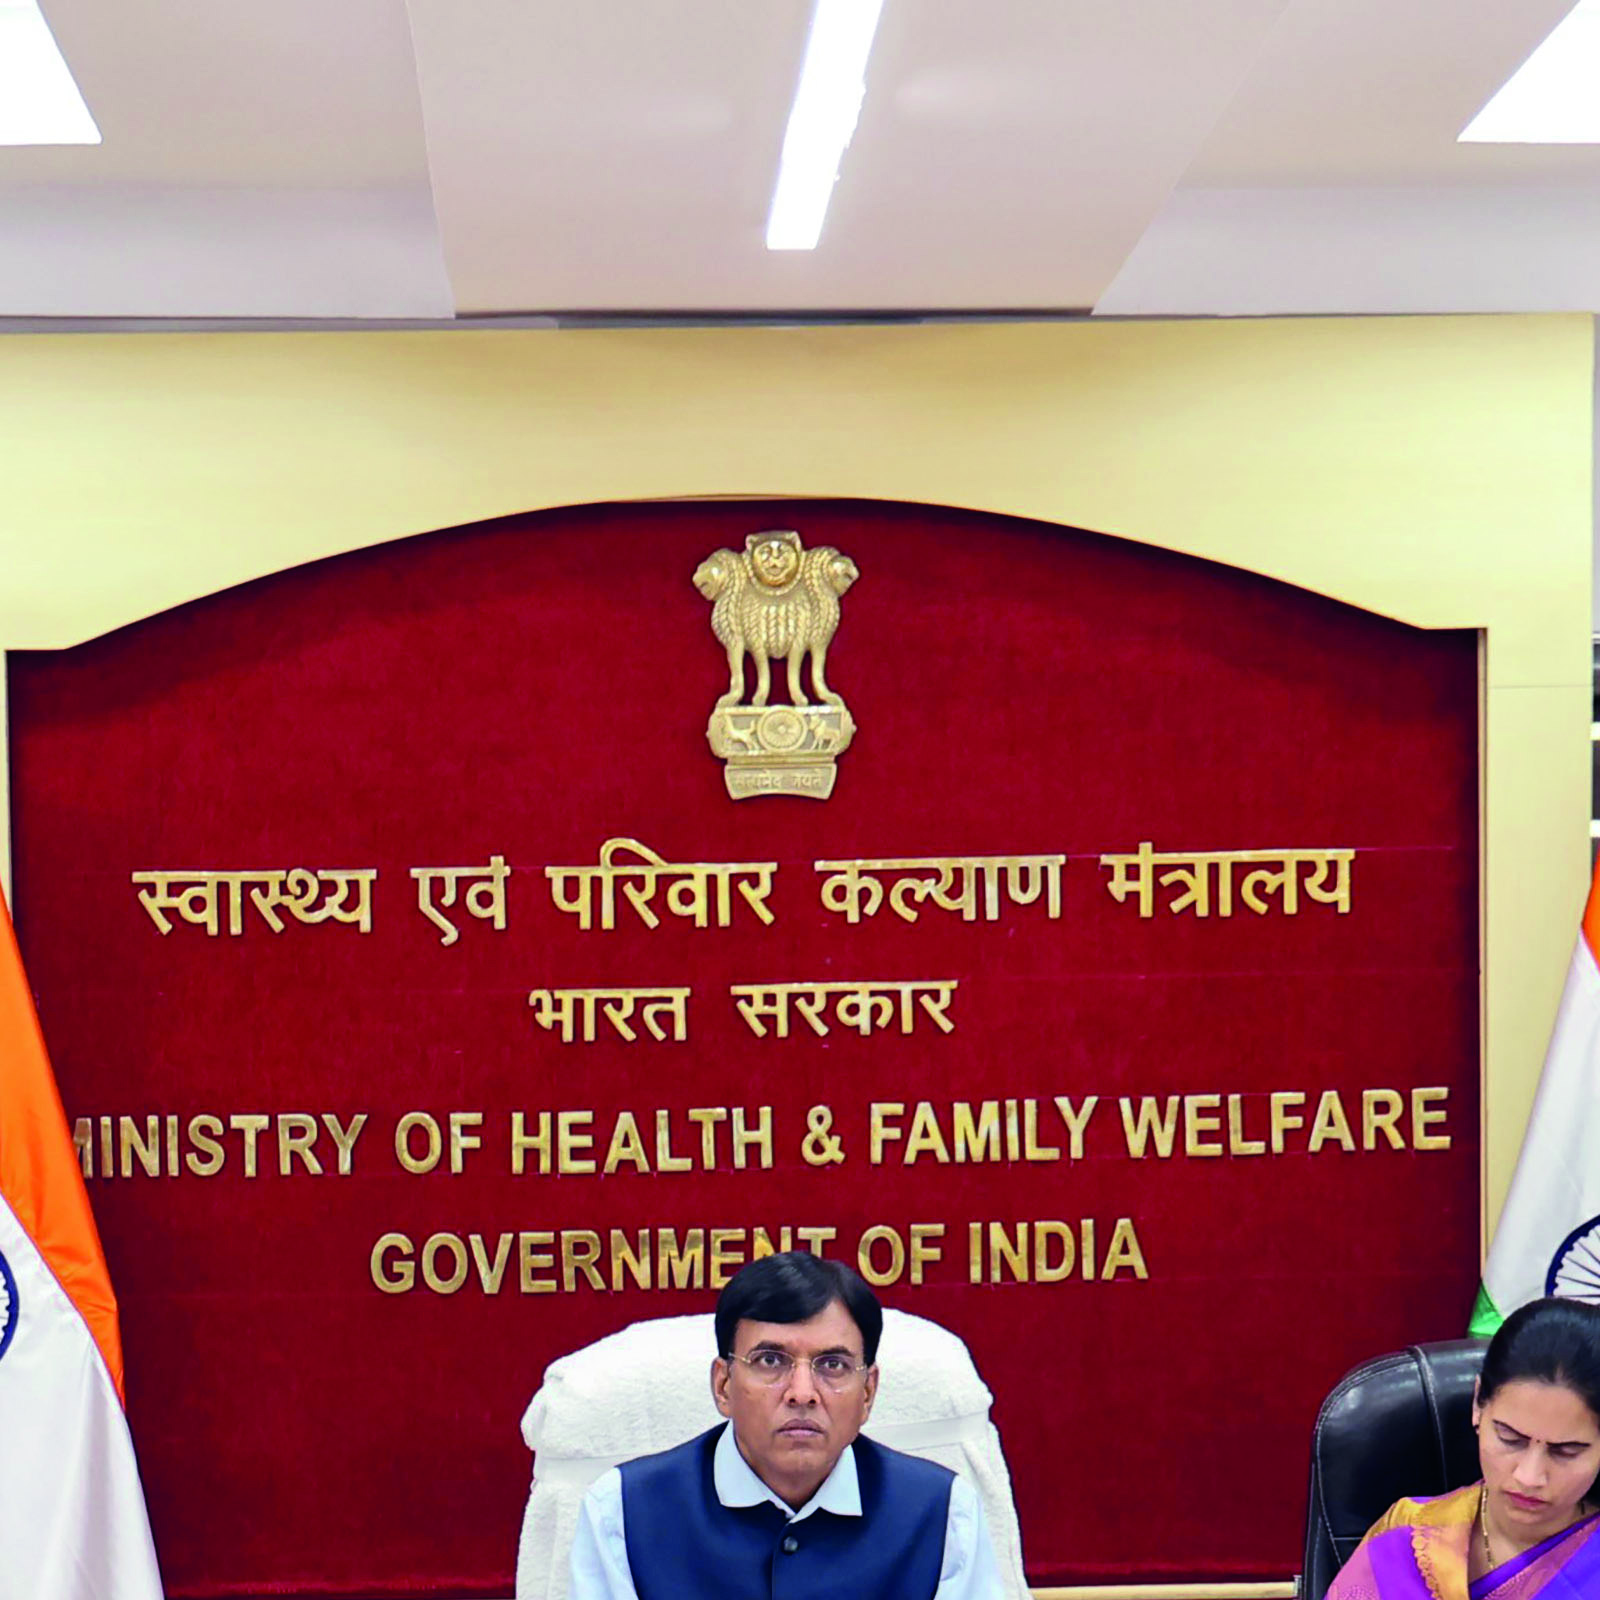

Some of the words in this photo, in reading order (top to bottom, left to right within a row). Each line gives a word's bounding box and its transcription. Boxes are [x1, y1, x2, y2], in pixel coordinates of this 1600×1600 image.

[131, 868, 378, 938] स्वास्थ्य
[411, 855, 512, 946] एवं
[545, 838, 778, 930] परिवार
[814, 854, 1067, 924] कल्याण
[1104, 842, 1356, 920] मंत्रालय
[528, 986, 691, 1044] भारत
[731, 980, 958, 1039] सरकार
[394, 1111, 483, 1175] OF
[511, 1105, 773, 1175] HEALTH
[801, 1104, 846, 1166] &
[870, 1096, 1099, 1165] FAMILY
[1117, 1087, 1452, 1159] WELFARE
[857, 1223, 945, 1287] OF
[968, 1217, 1149, 1284] INDIA
